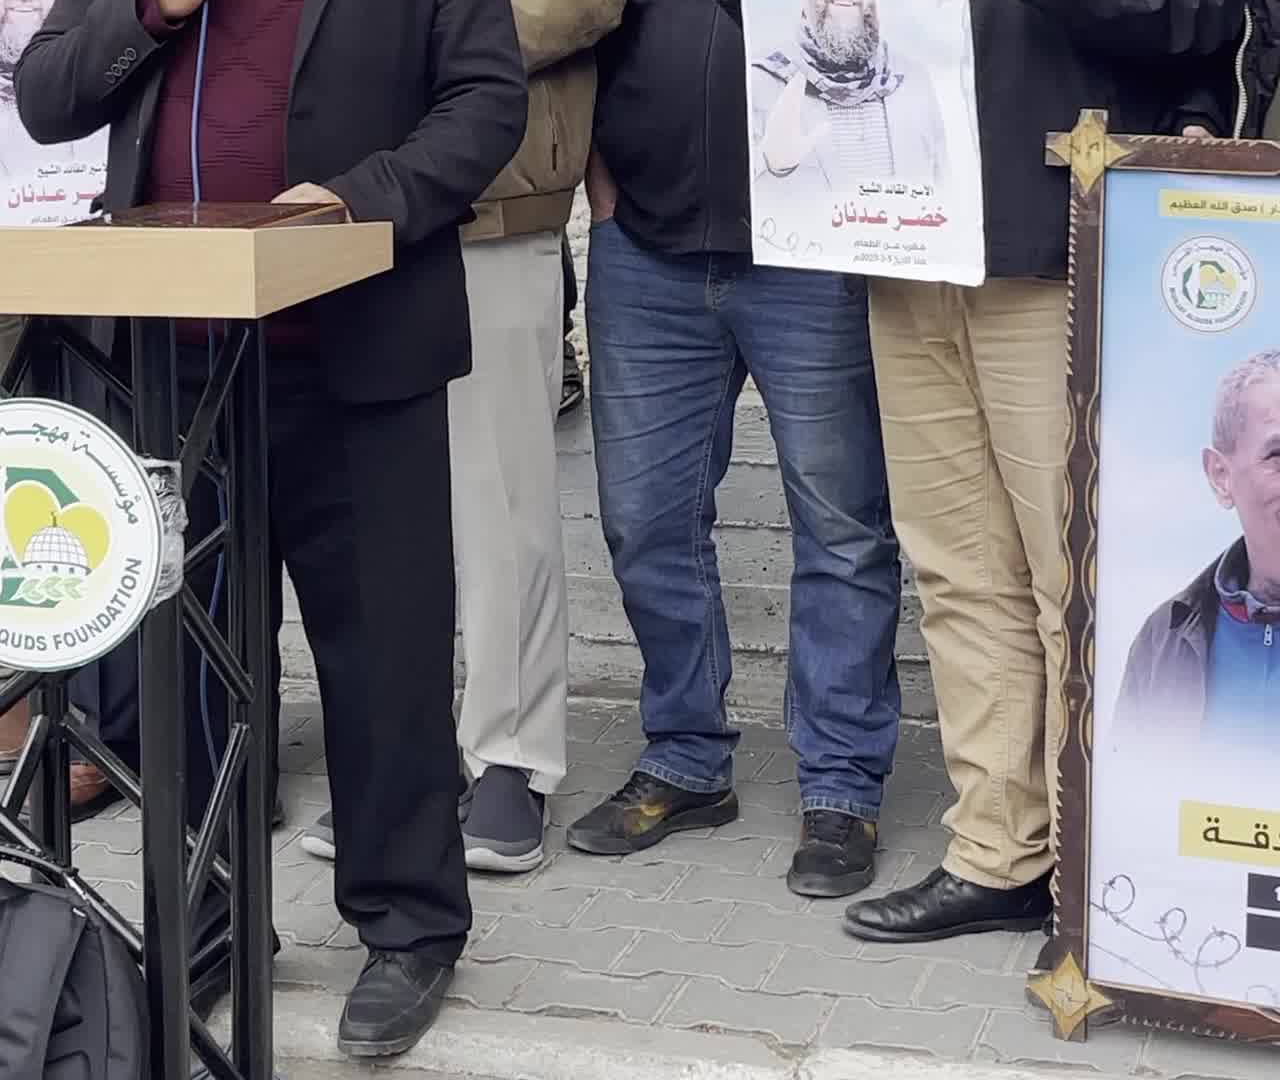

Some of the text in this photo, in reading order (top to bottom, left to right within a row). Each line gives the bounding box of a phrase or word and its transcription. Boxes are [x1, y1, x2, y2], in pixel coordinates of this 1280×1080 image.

[831, 200, 948, 231] خضر عدنان
[52, 557, 142, 651] FOUNDATION
